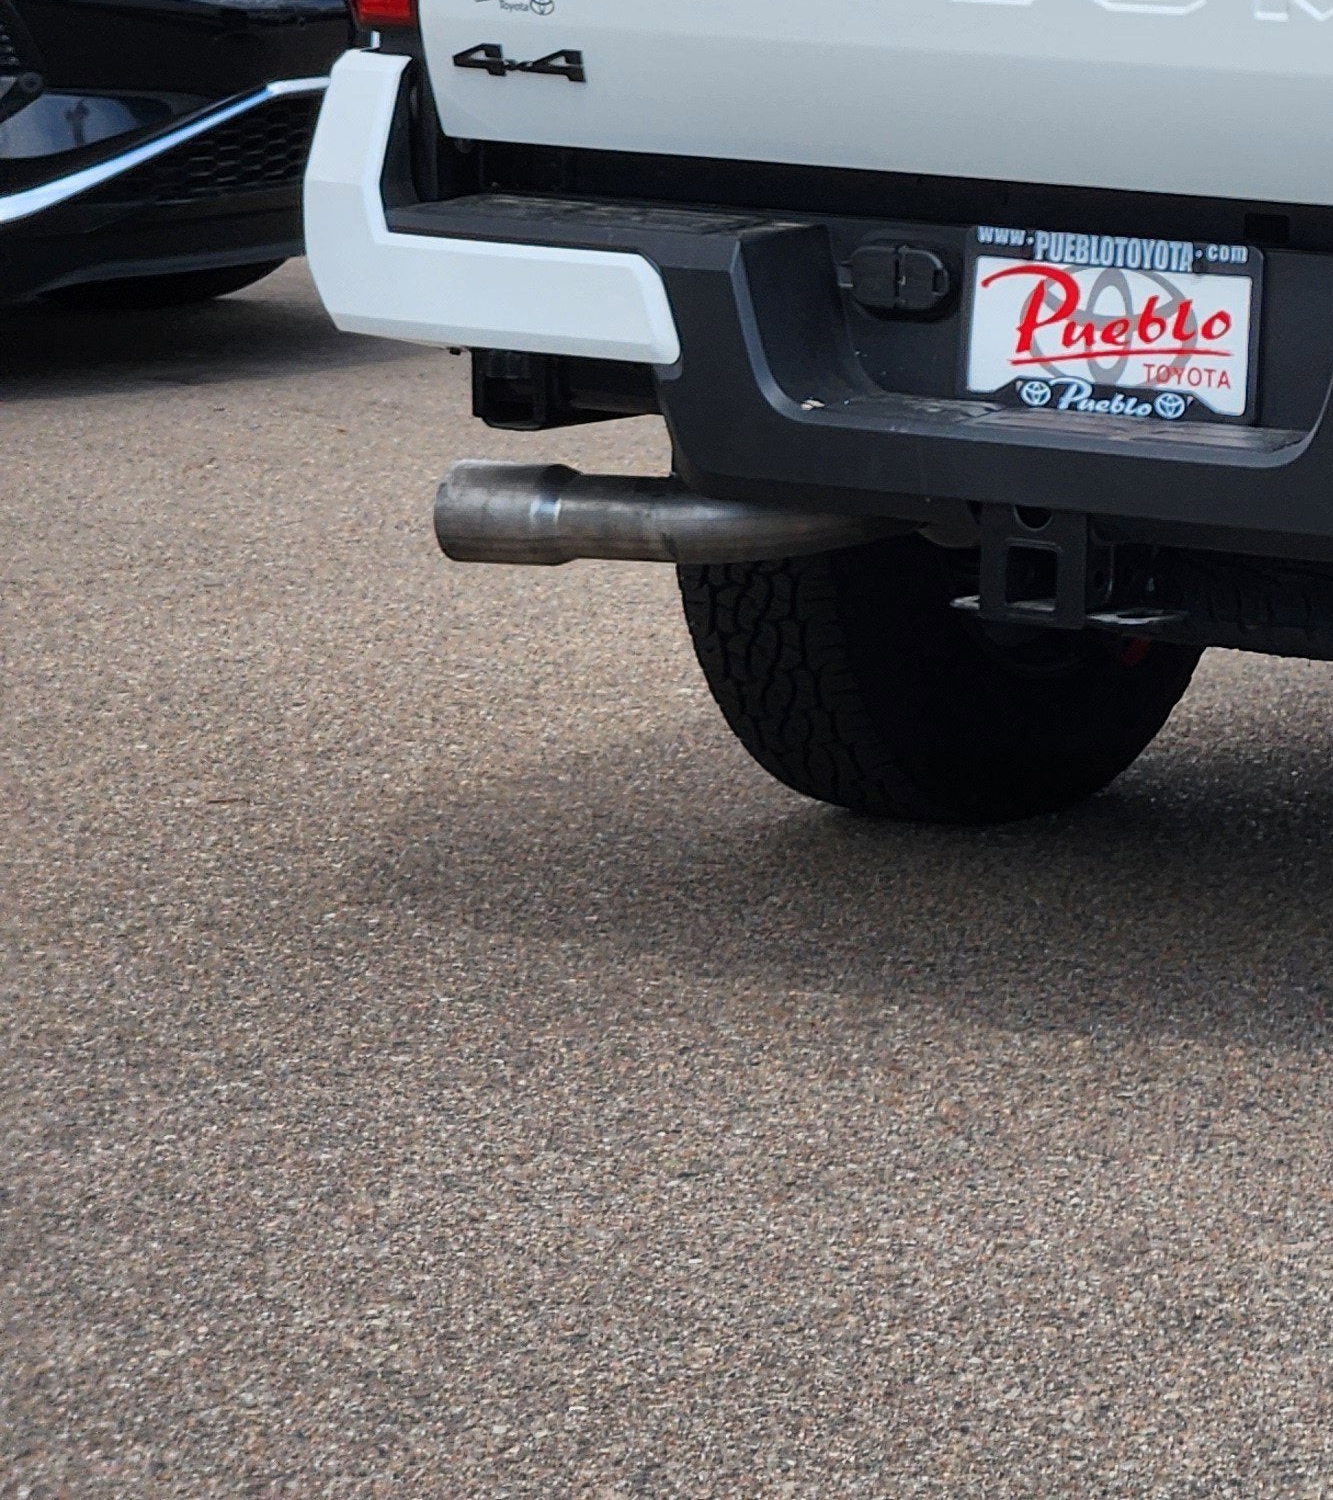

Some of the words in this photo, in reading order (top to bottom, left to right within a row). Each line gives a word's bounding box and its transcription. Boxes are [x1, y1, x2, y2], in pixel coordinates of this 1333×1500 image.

[499, 0, 530, 13] Toyota
[452, 42, 587, 84] 4x4
[980, 262, 1232, 353] Pueblo
[1050, 376, 1153, 418] Pueblo
[1142, 362, 1232, 391] TOYOTA
